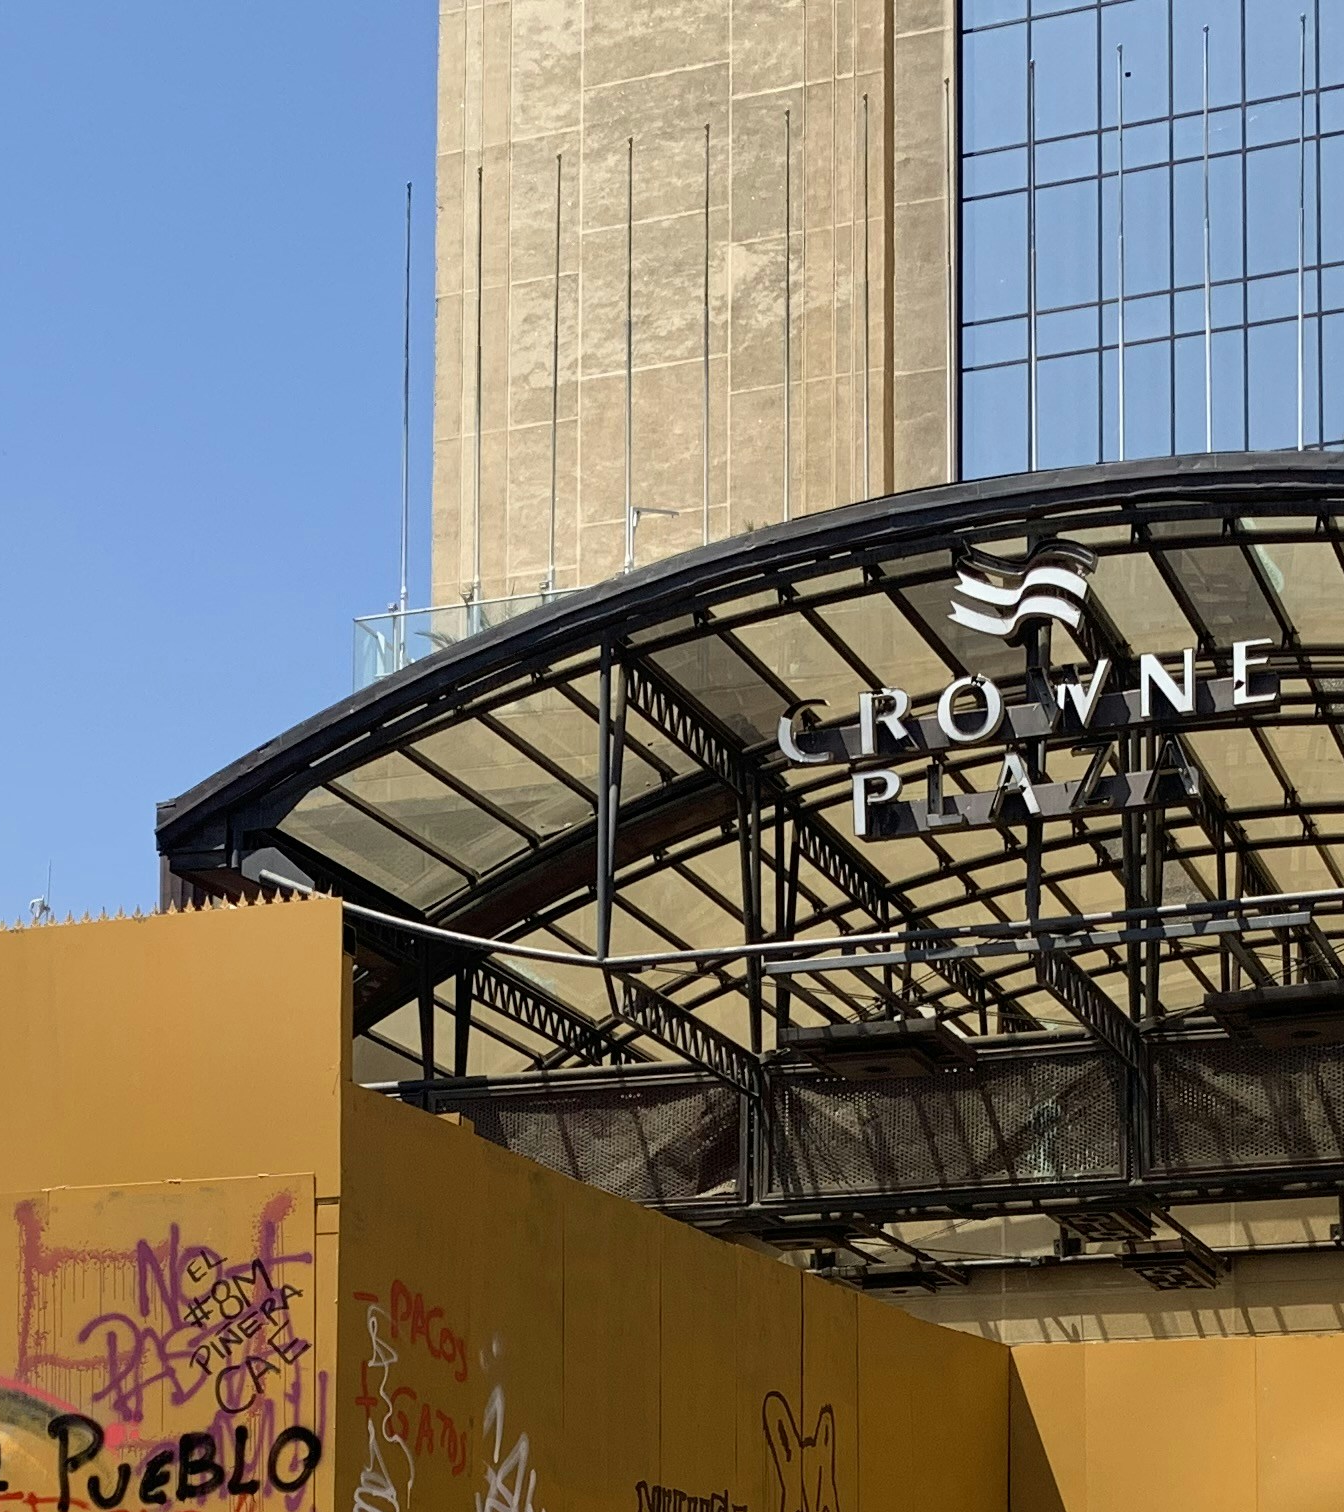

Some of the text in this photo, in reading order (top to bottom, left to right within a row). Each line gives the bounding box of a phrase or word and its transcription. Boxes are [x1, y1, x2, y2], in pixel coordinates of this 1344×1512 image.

[777, 637, 1280, 764] CROWNE
[852, 740, 1201, 837] PLAZA
[184, 1258, 274, 1327] #8M
[187, 1250, 228, 1283] EL
[215, 1320, 312, 1414] CAE
